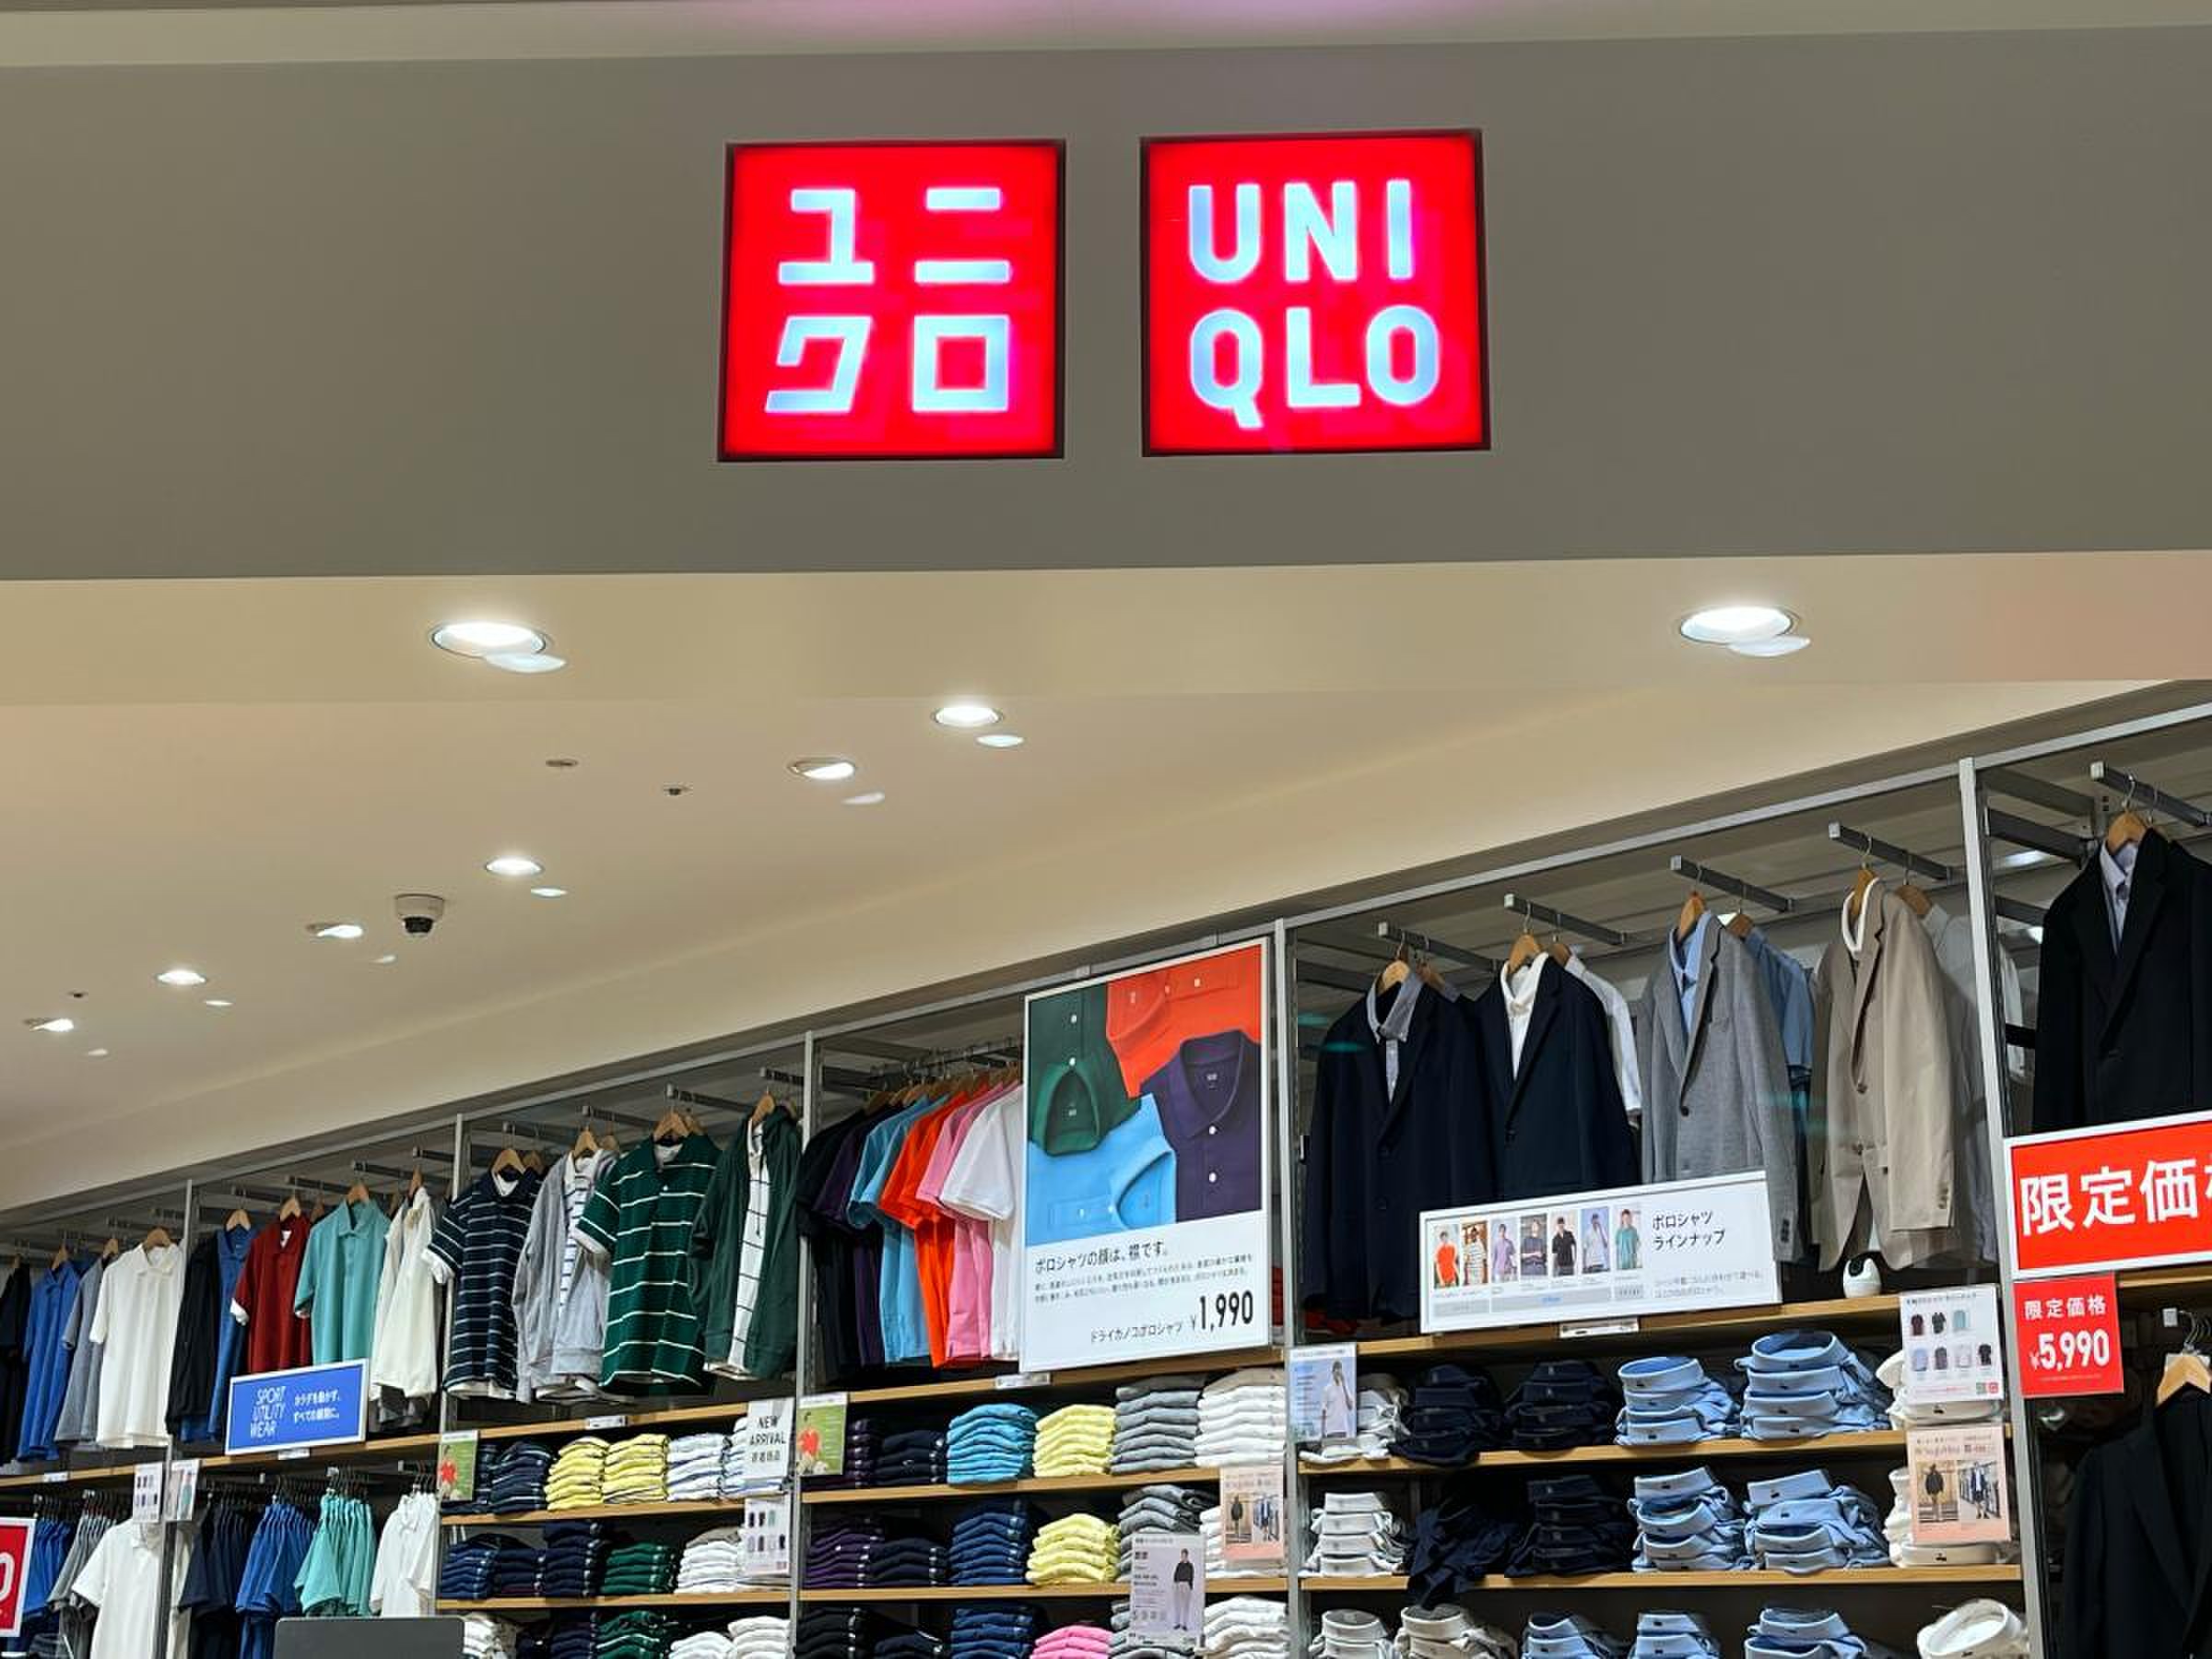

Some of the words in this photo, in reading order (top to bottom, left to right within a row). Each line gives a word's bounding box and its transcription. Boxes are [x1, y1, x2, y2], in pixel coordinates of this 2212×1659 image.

[778, 187, 1011, 284] ユニ
[1187, 179, 1412, 284] UNI
[765, 313, 1011, 413] クロ
[1188, 305, 1441, 429] QLO
[2019, 1158, 2212, 1237] 限定価
[1653, 1210, 1712, 1230] ポロシャツ
[1653, 1228, 1726, 1251] ラインナップ
[1190, 1289, 1254, 1333] ¥1,990
[2024, 1293, 2107, 1322] 限定価格
[2030, 1328, 2110, 1371] ¥5,990
[256, 1385, 287, 1406] SPORT
[253, 1403, 287, 1422] UTILITY
[758, 1415, 781, 1430] NEW
[250, 1420, 277, 1439] WEAR
[750, 1430, 787, 1446] ARRIVAL
